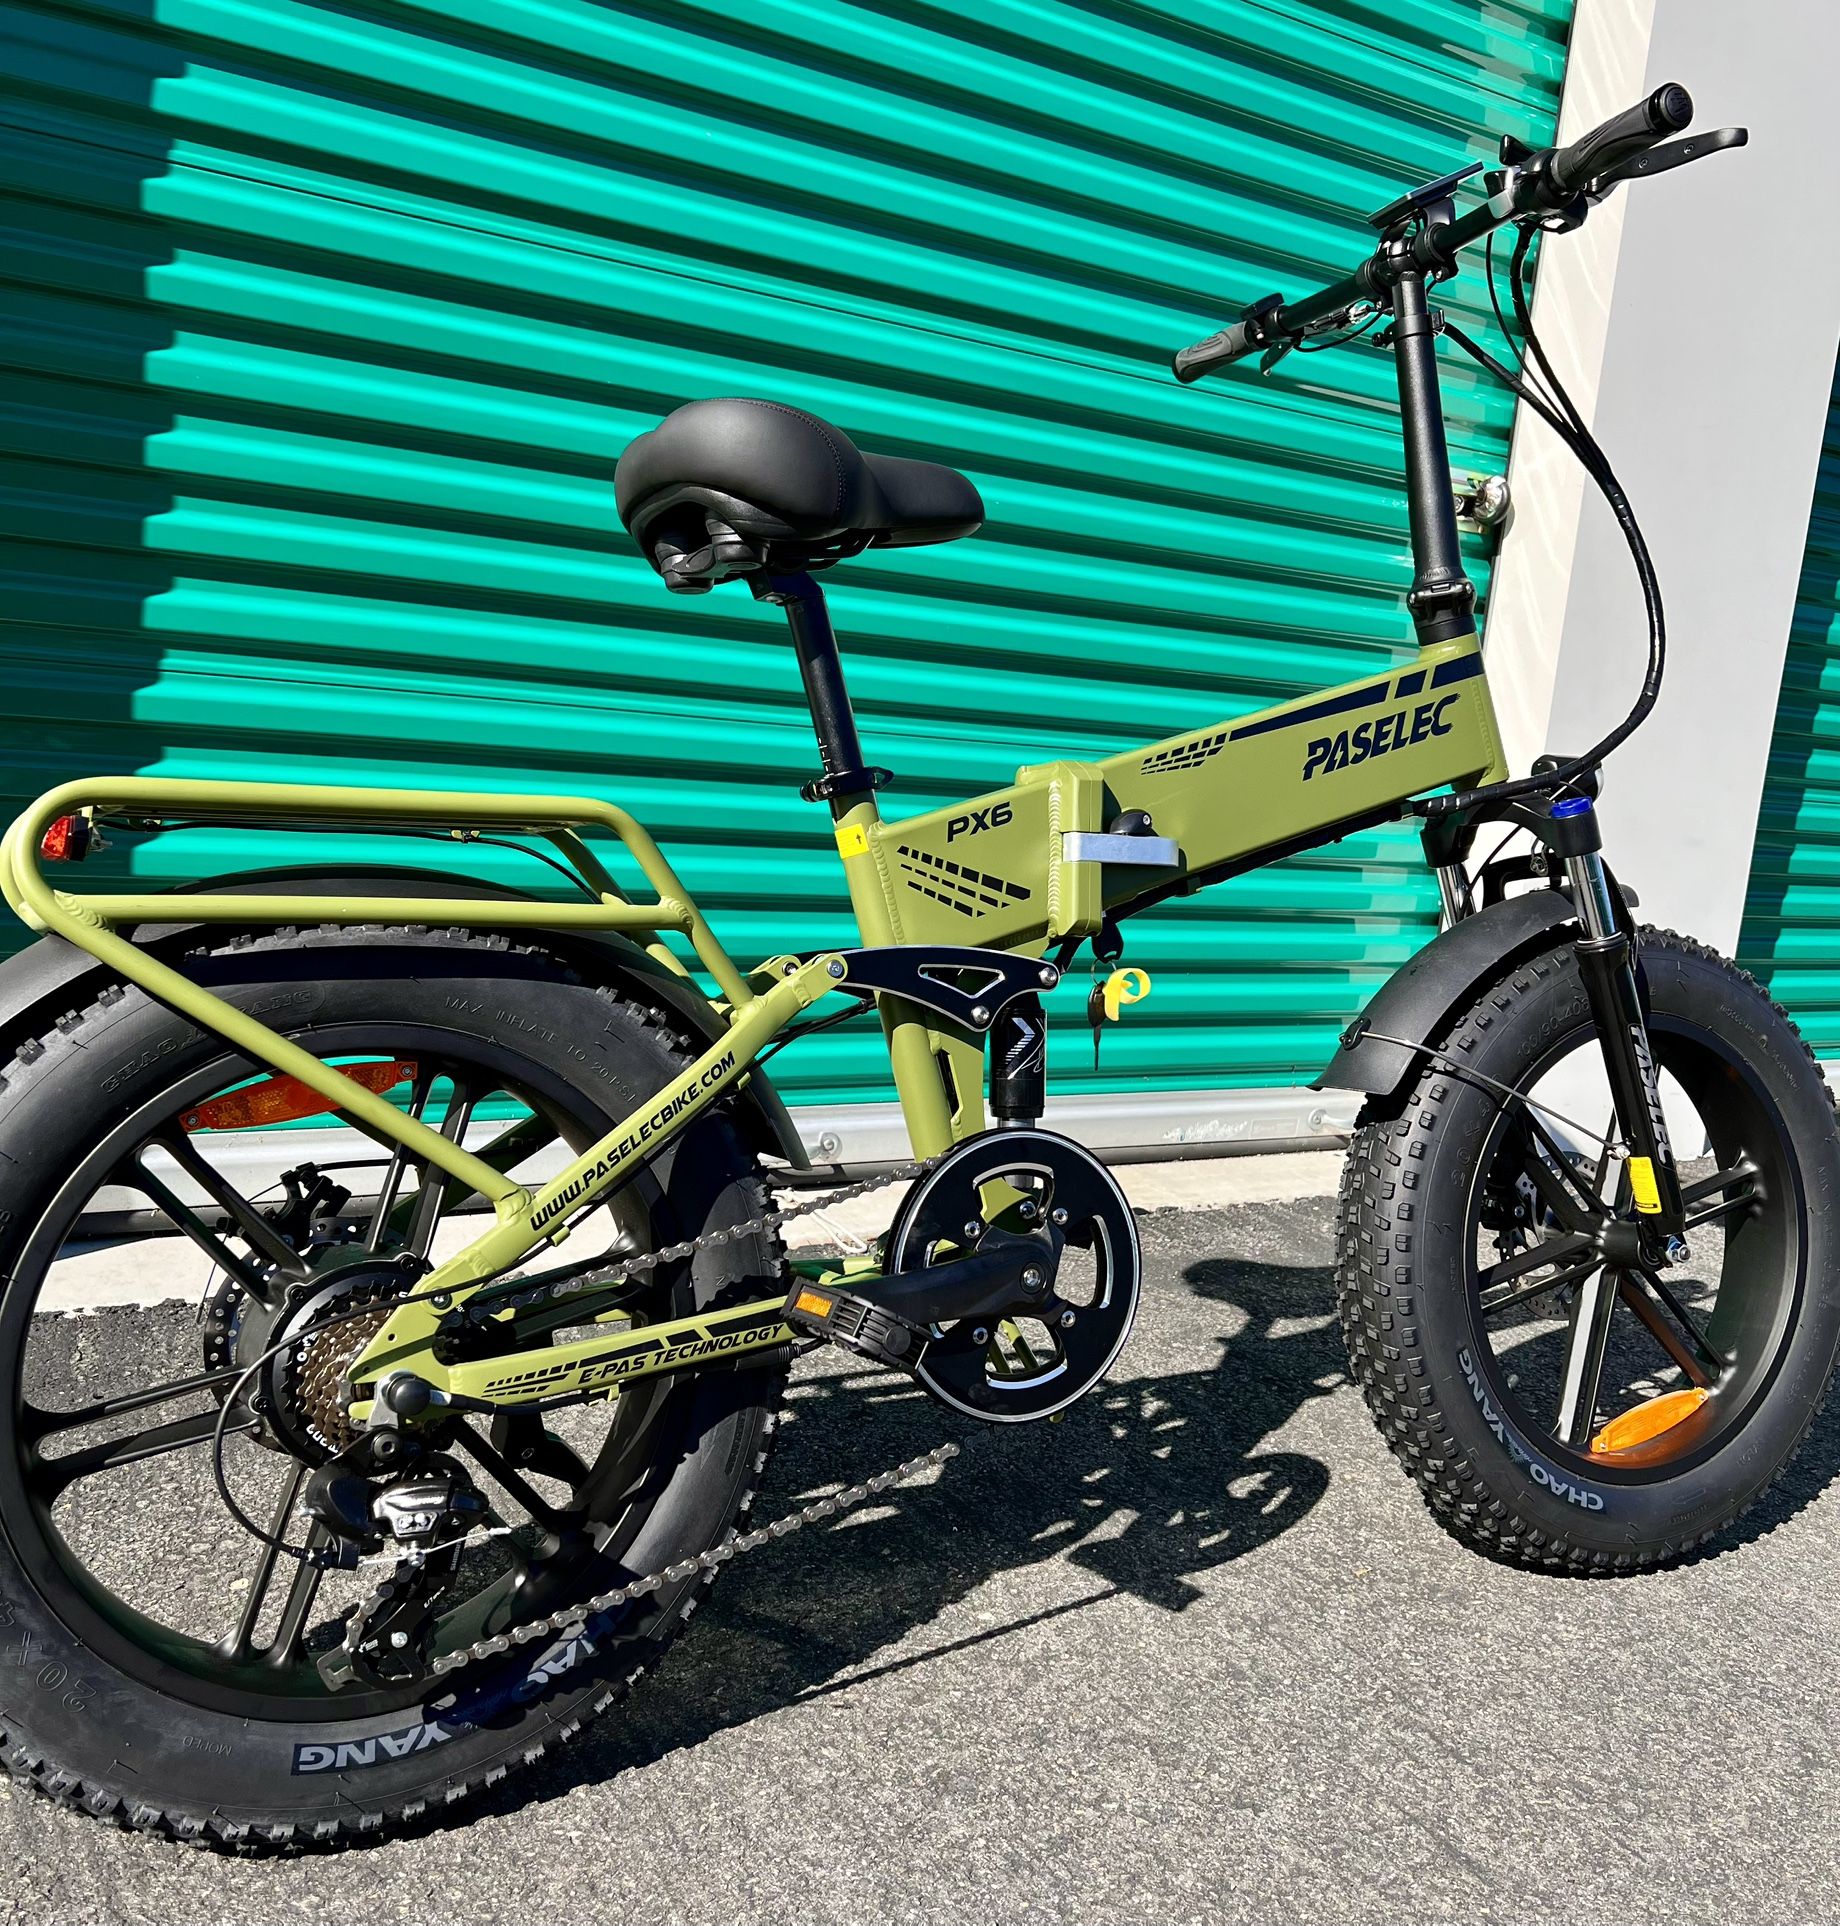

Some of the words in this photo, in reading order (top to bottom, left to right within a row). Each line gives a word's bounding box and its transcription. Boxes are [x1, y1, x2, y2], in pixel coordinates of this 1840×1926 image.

[1302, 693, 1461, 781] PASELEC
[947, 801, 1013, 843] PX6
[237, 990, 312, 1016] ANG
[495, 1010, 559, 1043] INFLATE
[566, 1043, 587, 1061] TO
[1630, 1025, 1671, 1164] PASELEC
[529, 1050, 736, 1231] WWW.PASELECBIKE.COM
[578, 1353, 650, 1384] E-PAS
[653, 1322, 785, 1366] TECHNOLOGY
[1459, 1349, 1504, 1443] YANG
[1530, 1463, 1604, 1510] CHAO
[36, 1661, 97, 1713] 20
[299, 1720, 452, 1771] YANG
